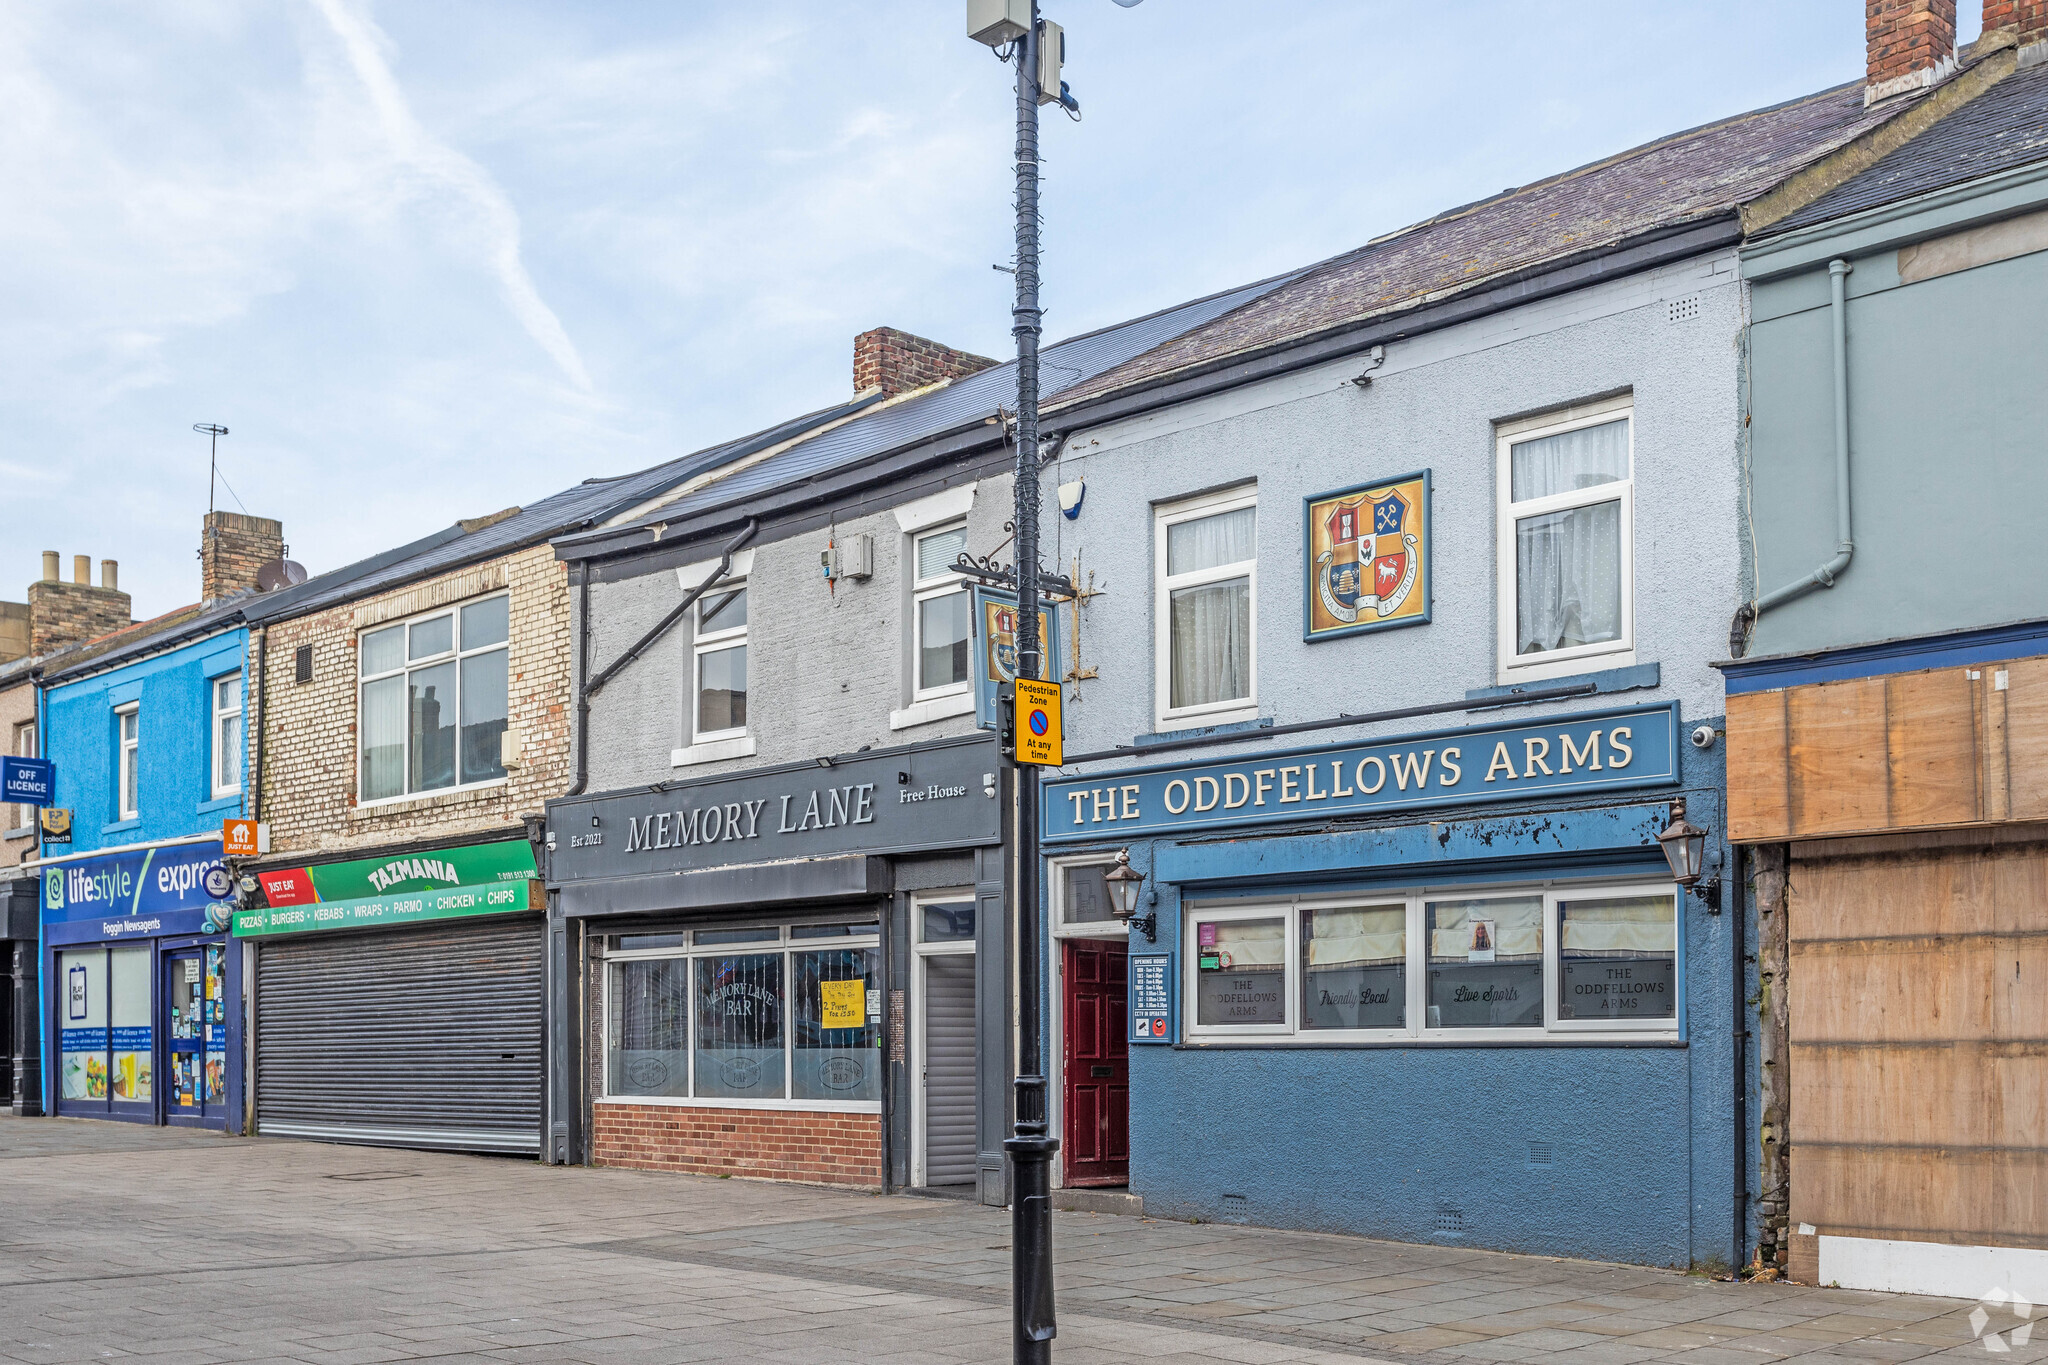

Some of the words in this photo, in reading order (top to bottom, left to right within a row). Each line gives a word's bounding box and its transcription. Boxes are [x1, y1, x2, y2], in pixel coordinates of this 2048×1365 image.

[1384, 600, 1394, 612] ET
[1395, 560, 1415, 600] VERITAS
[1334, 607, 1354, 620] AMOR
[1018, 683, 1058, 697] Pedestrian
[1029, 695, 1048, 706] Zone
[1027, 738, 1037, 748] At
[1038, 740, 1052, 750] any
[1031, 749, 1048, 760] time
[18, 769, 37, 780] OFF
[1068, 784, 1140, 824] THE
[1164, 747, 1462, 815] ODDFELLOWS
[1484, 727, 1633, 782] ARMS
[7, 780, 47, 793] LICENCE
[899, 788, 926, 803] Free
[928, 785, 966, 800] House
[625, 799, 767, 852] MEMORY
[777, 783, 874, 833] LANE
[571, 835, 583, 848] Est
[584, 833, 602, 846] 2021
[367, 859, 460, 892] TAZMANIA
[68, 863, 131, 908] lifestyle
[268, 881, 282, 893] JUST
[282, 880, 294, 891] EAT
[240, 916, 263, 929] PIZZAS
[271, 911, 305, 925] BURGERS
[314, 907, 344, 921] KEBABS
[354, 903, 383, 918] WRAPS
[393, 899, 423, 914] PARMO
[437, 894, 475, 910] CHICKEN
[487, 889, 515, 904] CHIPS
[103, 921, 124, 937] Foggin
[124, 918, 160, 934] Newsagents
[1606, 968, 1632, 979] THE
[73, 985, 83, 993] PLAY
[1233, 981, 1253, 990] THE
[1574, 982, 1665, 995] ODDFELLOWS
[706, 983, 747, 1008] MEMORY
[747, 984, 775, 1006] LANE
[1319, 989, 1358, 1009] Friendly
[1360, 988, 1389, 1004] Local
[1453, 986, 1480, 1003] Live
[1482, 985, 1519, 1005] Sports
[726, 1000, 752, 1016] BAR
[823, 1001, 829, 1010] 2
[1600, 998, 1638, 1009] ARMS
[1229, 1006, 1257, 1016] ARMS
[822, 1061, 845, 1075] MEMORY
[833, 1073, 849, 1083] BAR
